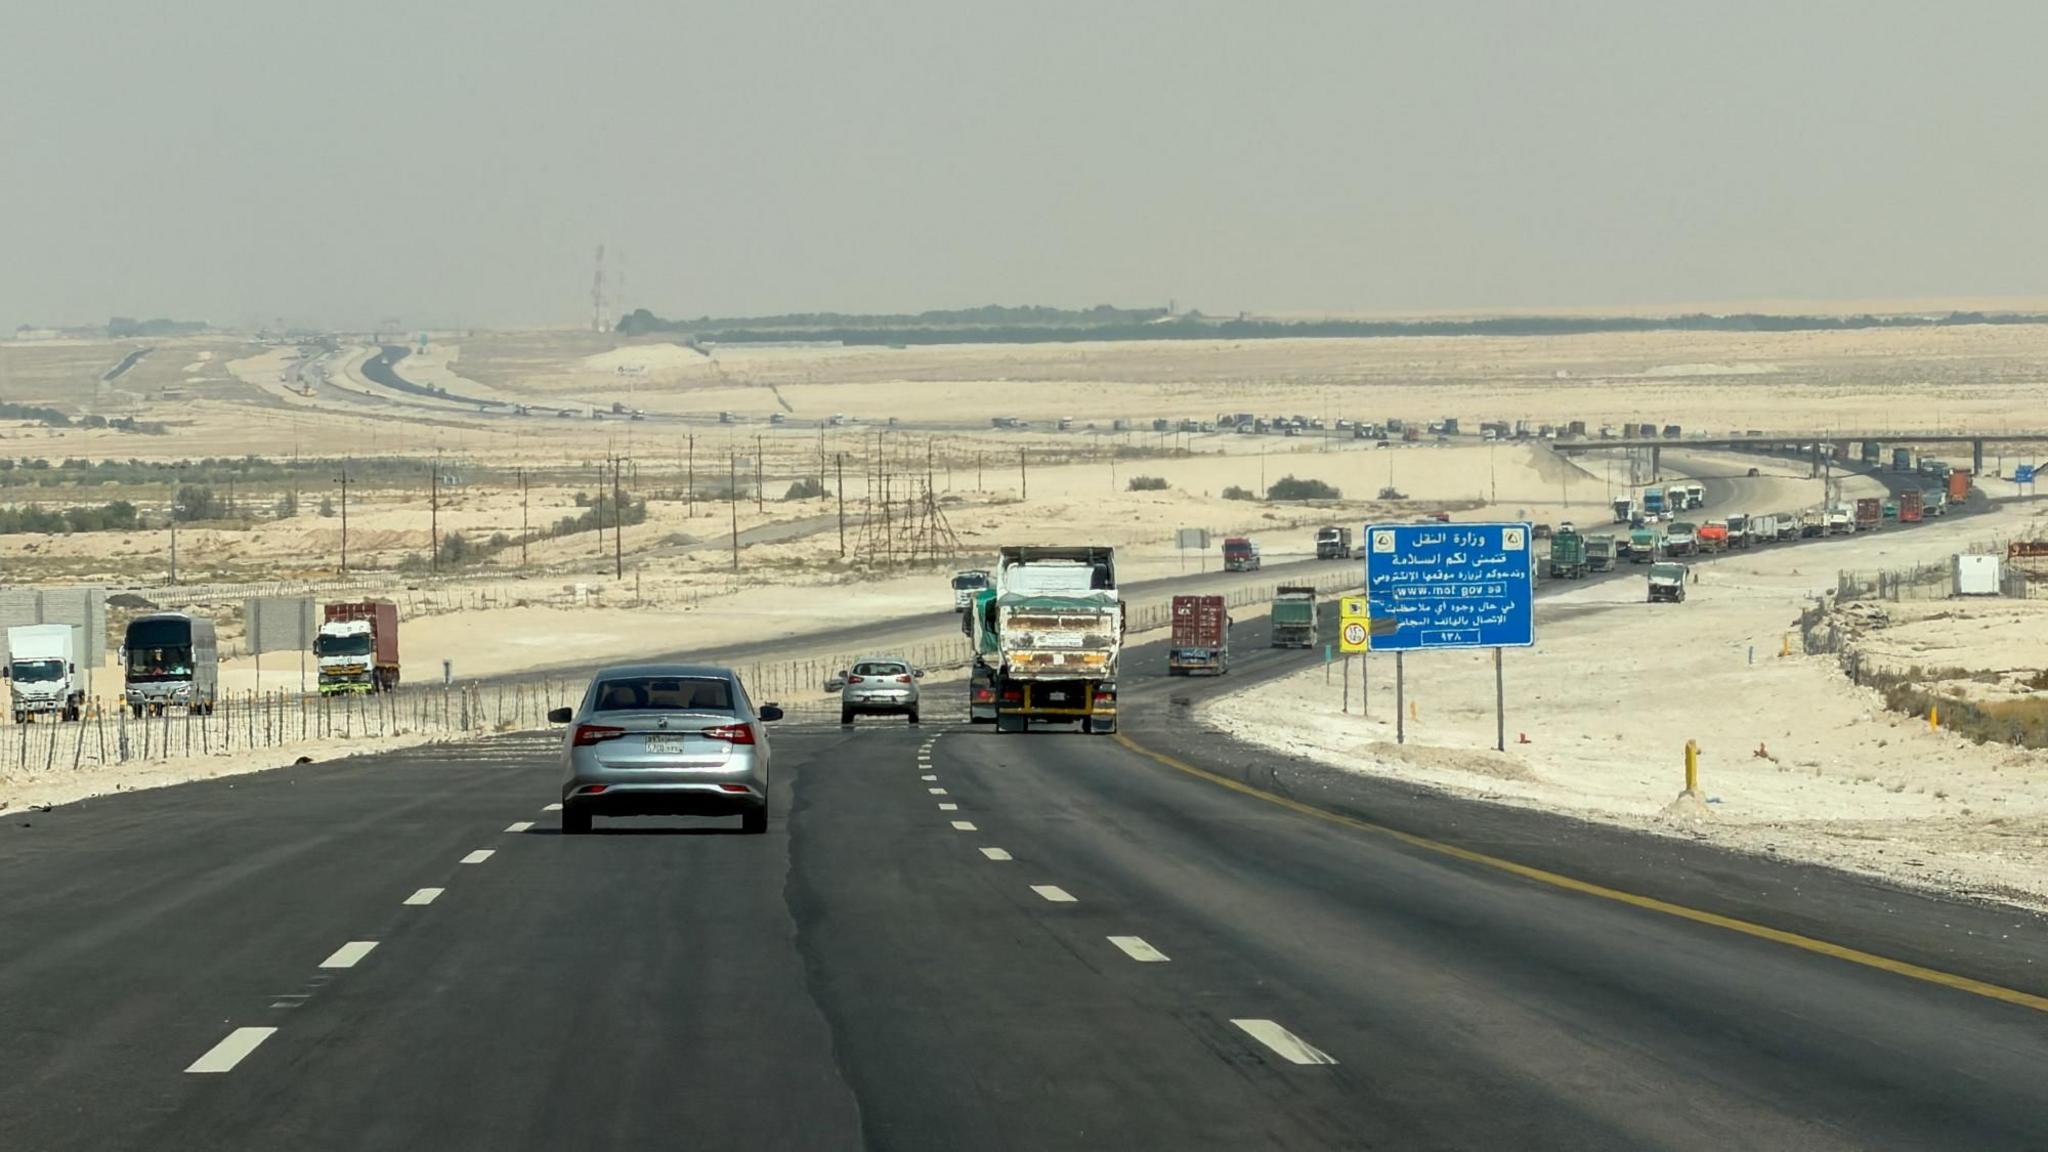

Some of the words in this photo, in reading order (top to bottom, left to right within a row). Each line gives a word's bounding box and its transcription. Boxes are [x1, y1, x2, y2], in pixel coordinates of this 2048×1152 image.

[1411, 532, 1446, 548] النقل
[1453, 531, 1486, 547] وزارة
[1391, 553, 1441, 566] السلامة
[1445, 552, 1467, 568] لكم
[1471, 552, 1507, 567] تتمنى
[1434, 600, 1447, 615] أي
[1451, 603, 1475, 613] وجود
[1478, 602, 1497, 613] حال
[1500, 601, 1516, 614] في
